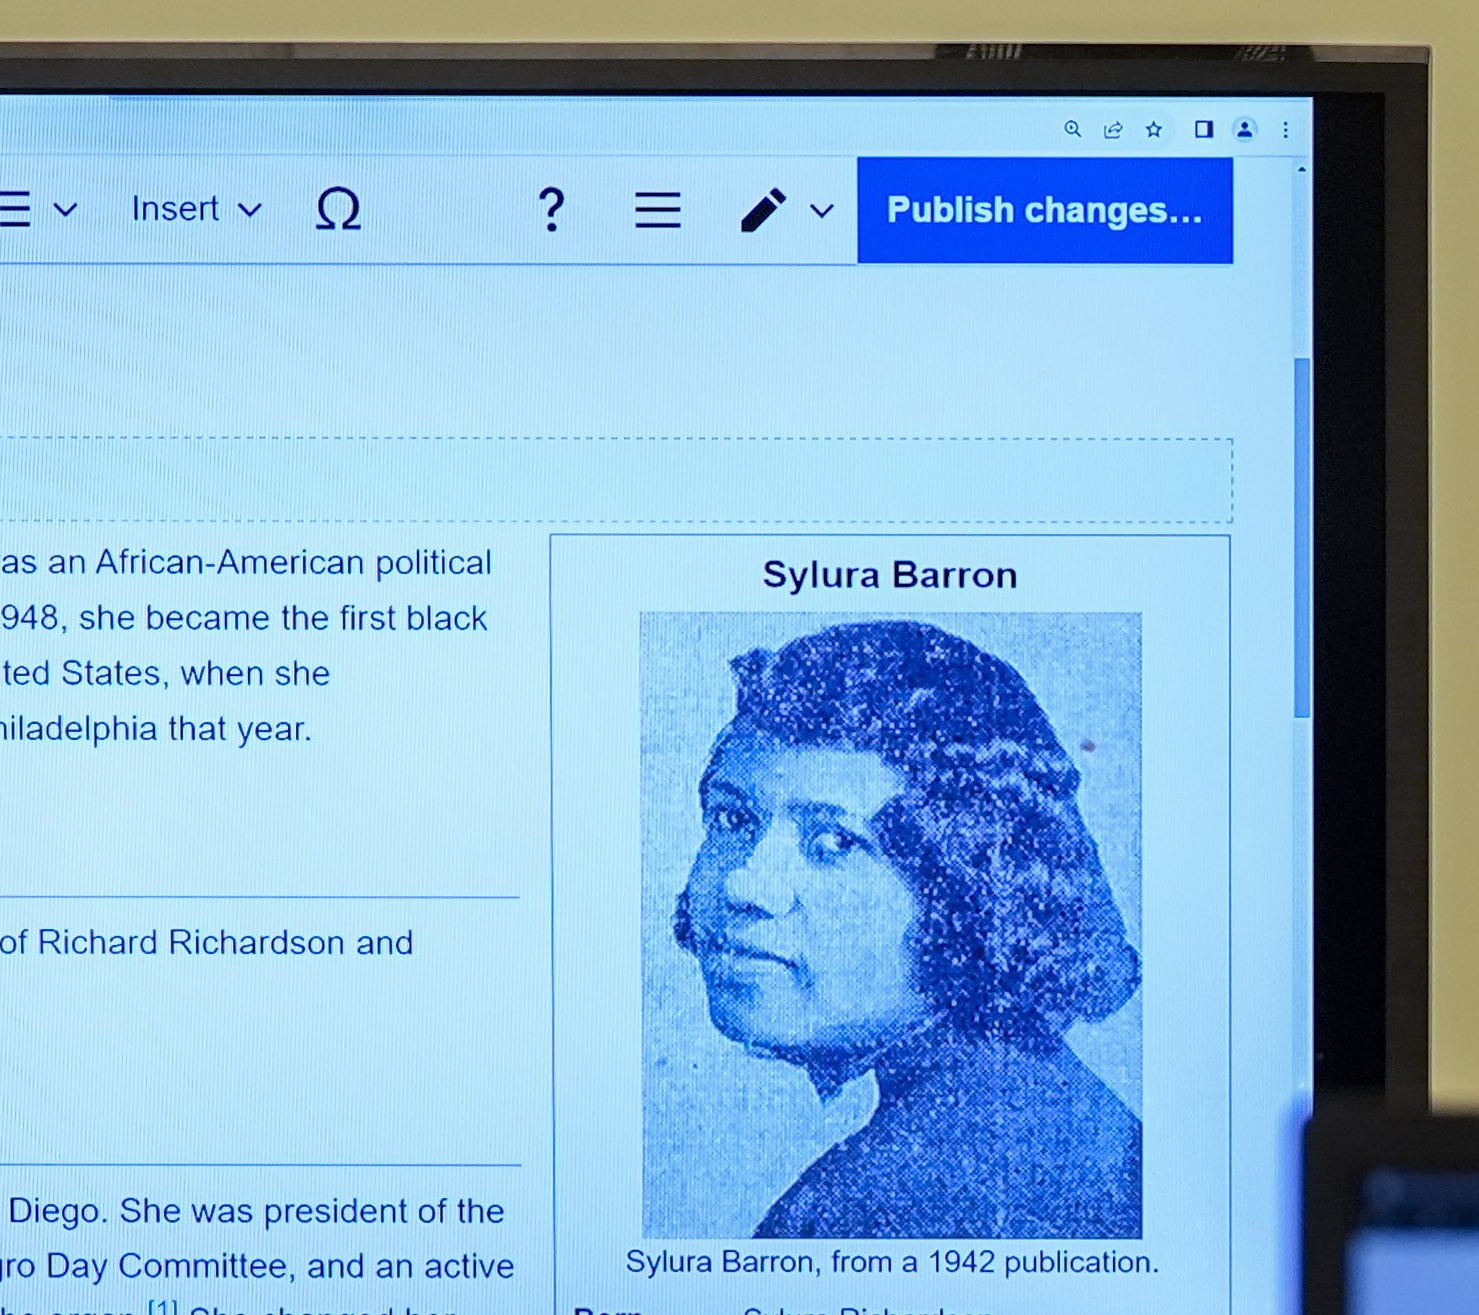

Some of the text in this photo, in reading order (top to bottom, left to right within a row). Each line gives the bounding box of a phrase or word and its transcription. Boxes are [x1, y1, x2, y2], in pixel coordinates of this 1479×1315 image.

[133, 194, 220, 222] Insert
[888, 195, 1202, 231] Publish changes...
[48, 554, 86, 575] an
[95, 547, 364, 575] African-American
[376, 548, 491, 582] political
[763, 559, 1017, 596] Sylura Barron
[79, 603, 135, 630] she
[146, 604, 270, 632] became
[281, 604, 329, 632] the
[340, 604, 397, 632] first
[407, 604, 488, 632] black
[168, 714, 227, 742] that
[237, 721, 311, 750] year.
[39, 928, 157, 955] Richard
[169, 929, 344, 956] Richardson
[356, 929, 413, 956] and
[9, 1196, 108, 1232] Diego.
[120, 1196, 181, 1224] She
[191, 1203, 254, 1224] was
[264, 1197, 408, 1232] president
[418, 1197, 448, 1225] of
[457, 1197, 505, 1224] the
[626, 1248, 1159, 1280] Sylura Barron, from a 1942 publication.
